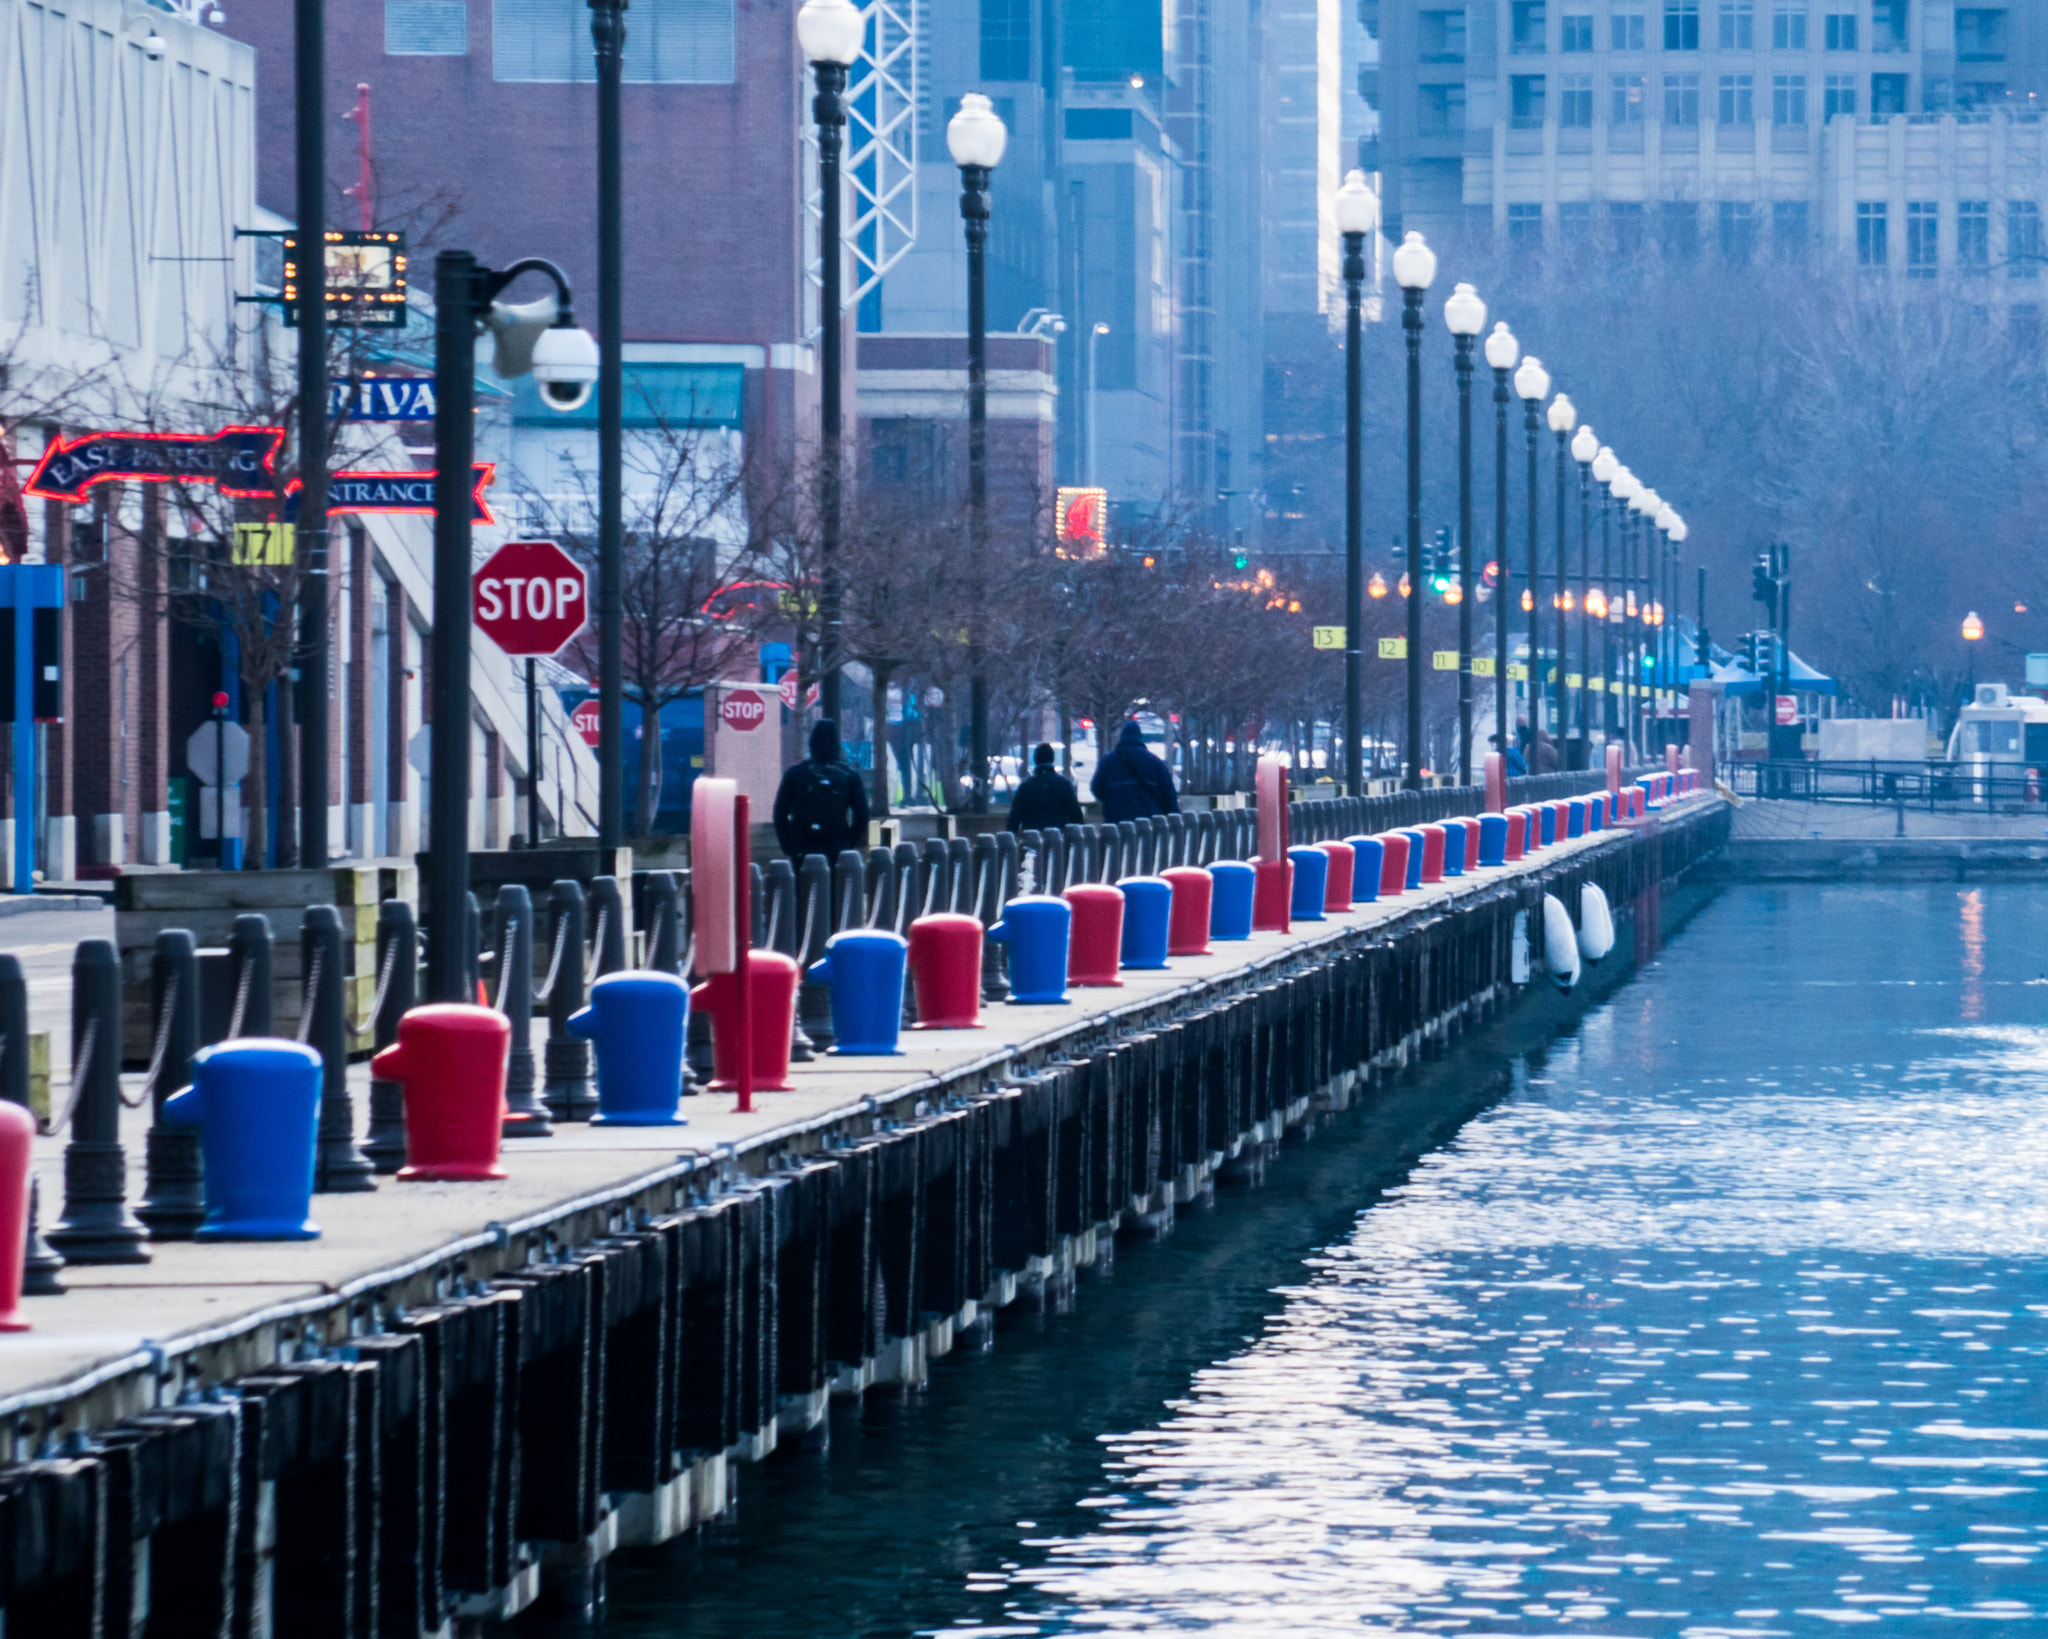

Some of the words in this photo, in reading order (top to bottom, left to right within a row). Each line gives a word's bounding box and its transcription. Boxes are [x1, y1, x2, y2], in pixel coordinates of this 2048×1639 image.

[50, 446, 120, 485] EAST
[326, 483, 435, 502] NTRANCE
[238, 529, 272, 559] 17
[478, 576, 580, 621] STOP
[1315, 629, 1333, 646] 13
[1380, 640, 1396, 656] 12
[1435, 654, 1446, 667] 11
[1472, 660, 1487, 673] 10
[1507, 666, 1517, 679] 9
[780, 681, 817, 697] STP
[725, 702, 763, 719] STOP
